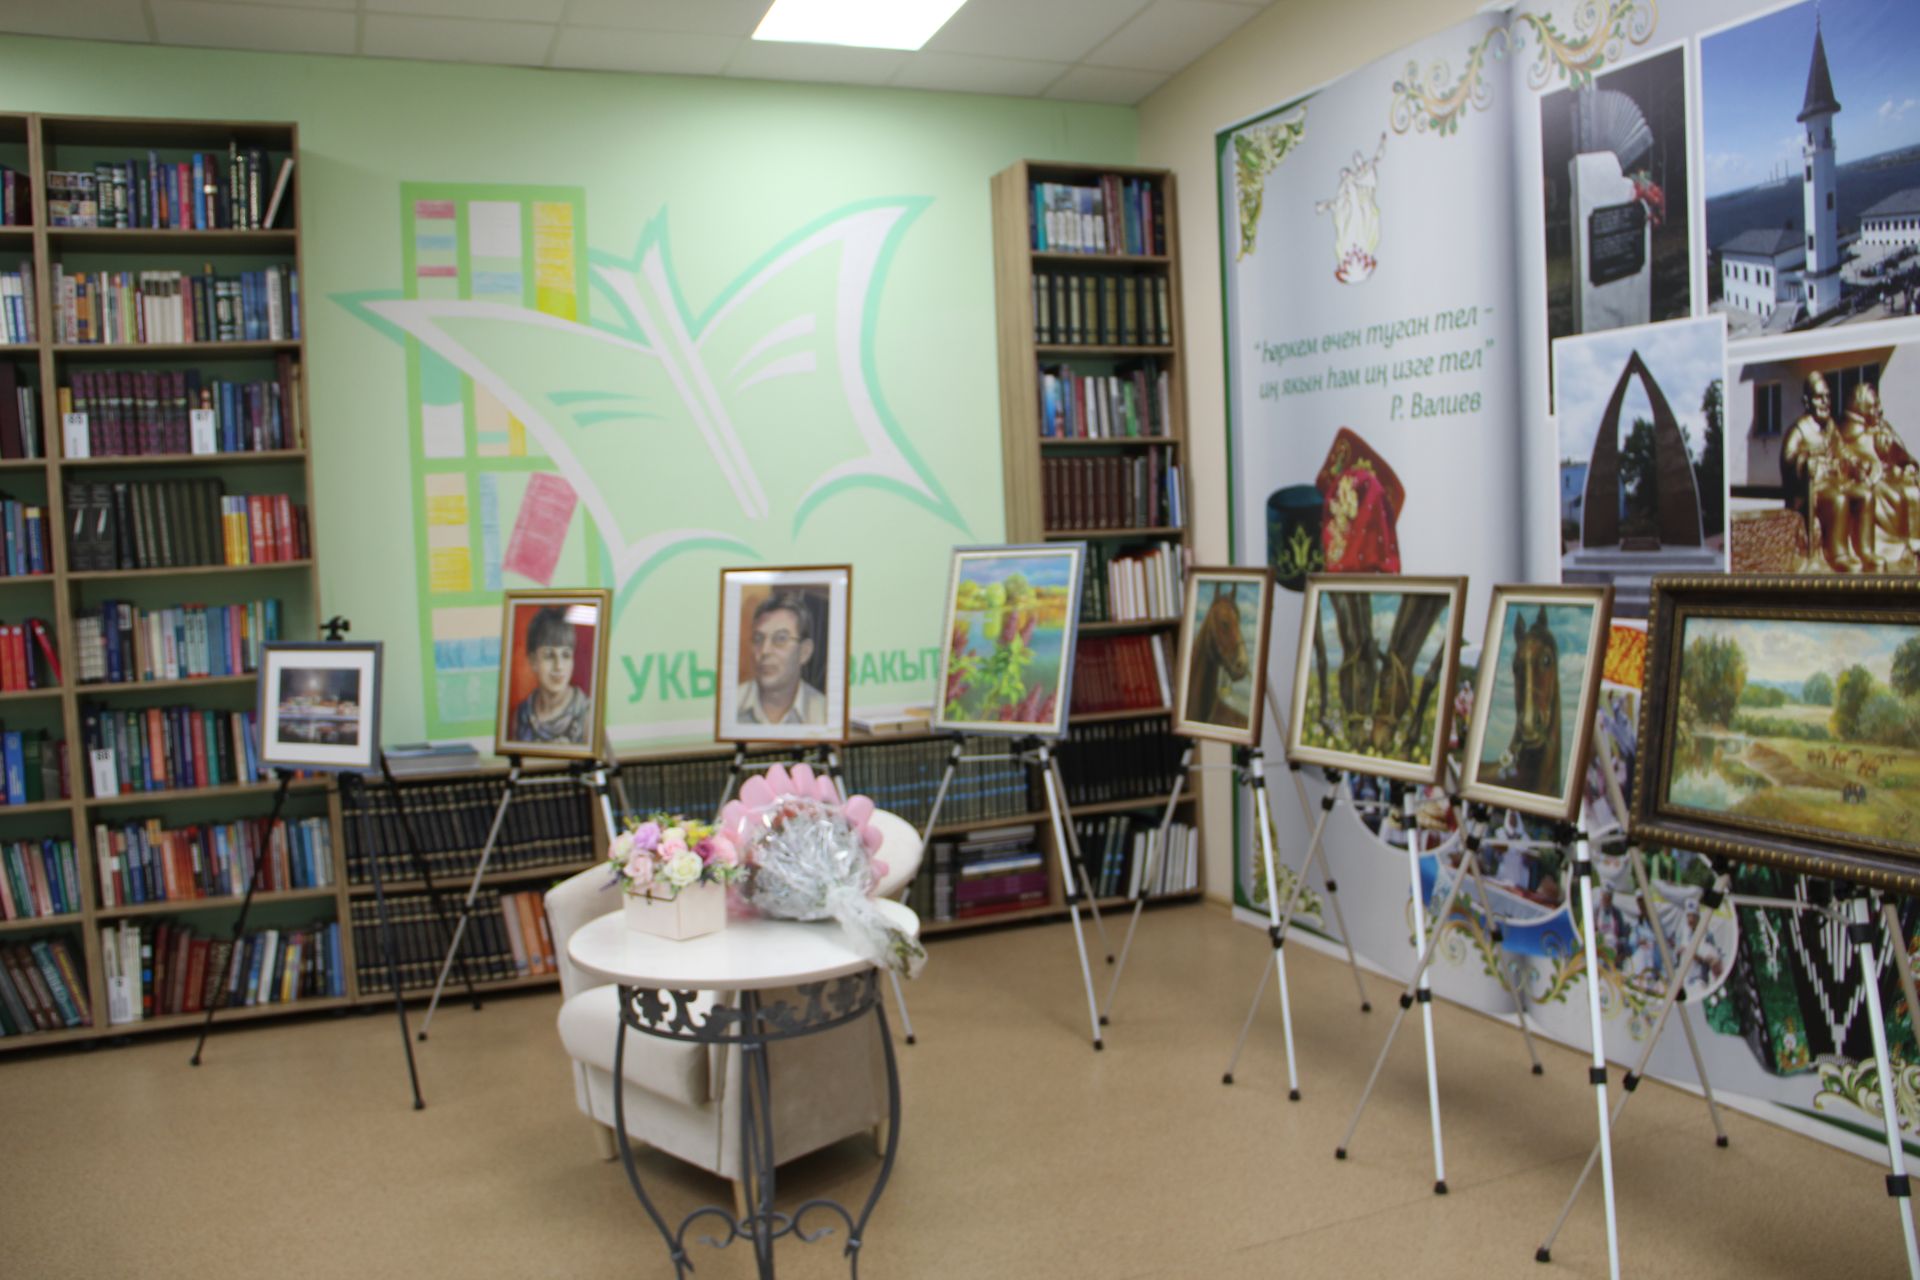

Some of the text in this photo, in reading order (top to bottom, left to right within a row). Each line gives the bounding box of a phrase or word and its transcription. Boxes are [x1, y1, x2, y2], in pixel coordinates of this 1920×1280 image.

[1366, 316, 1429, 349] туган
[1434, 306, 1477, 333] тел
[1393, 356, 1434, 380] изге
[1390, 393, 1404, 421] Р.
